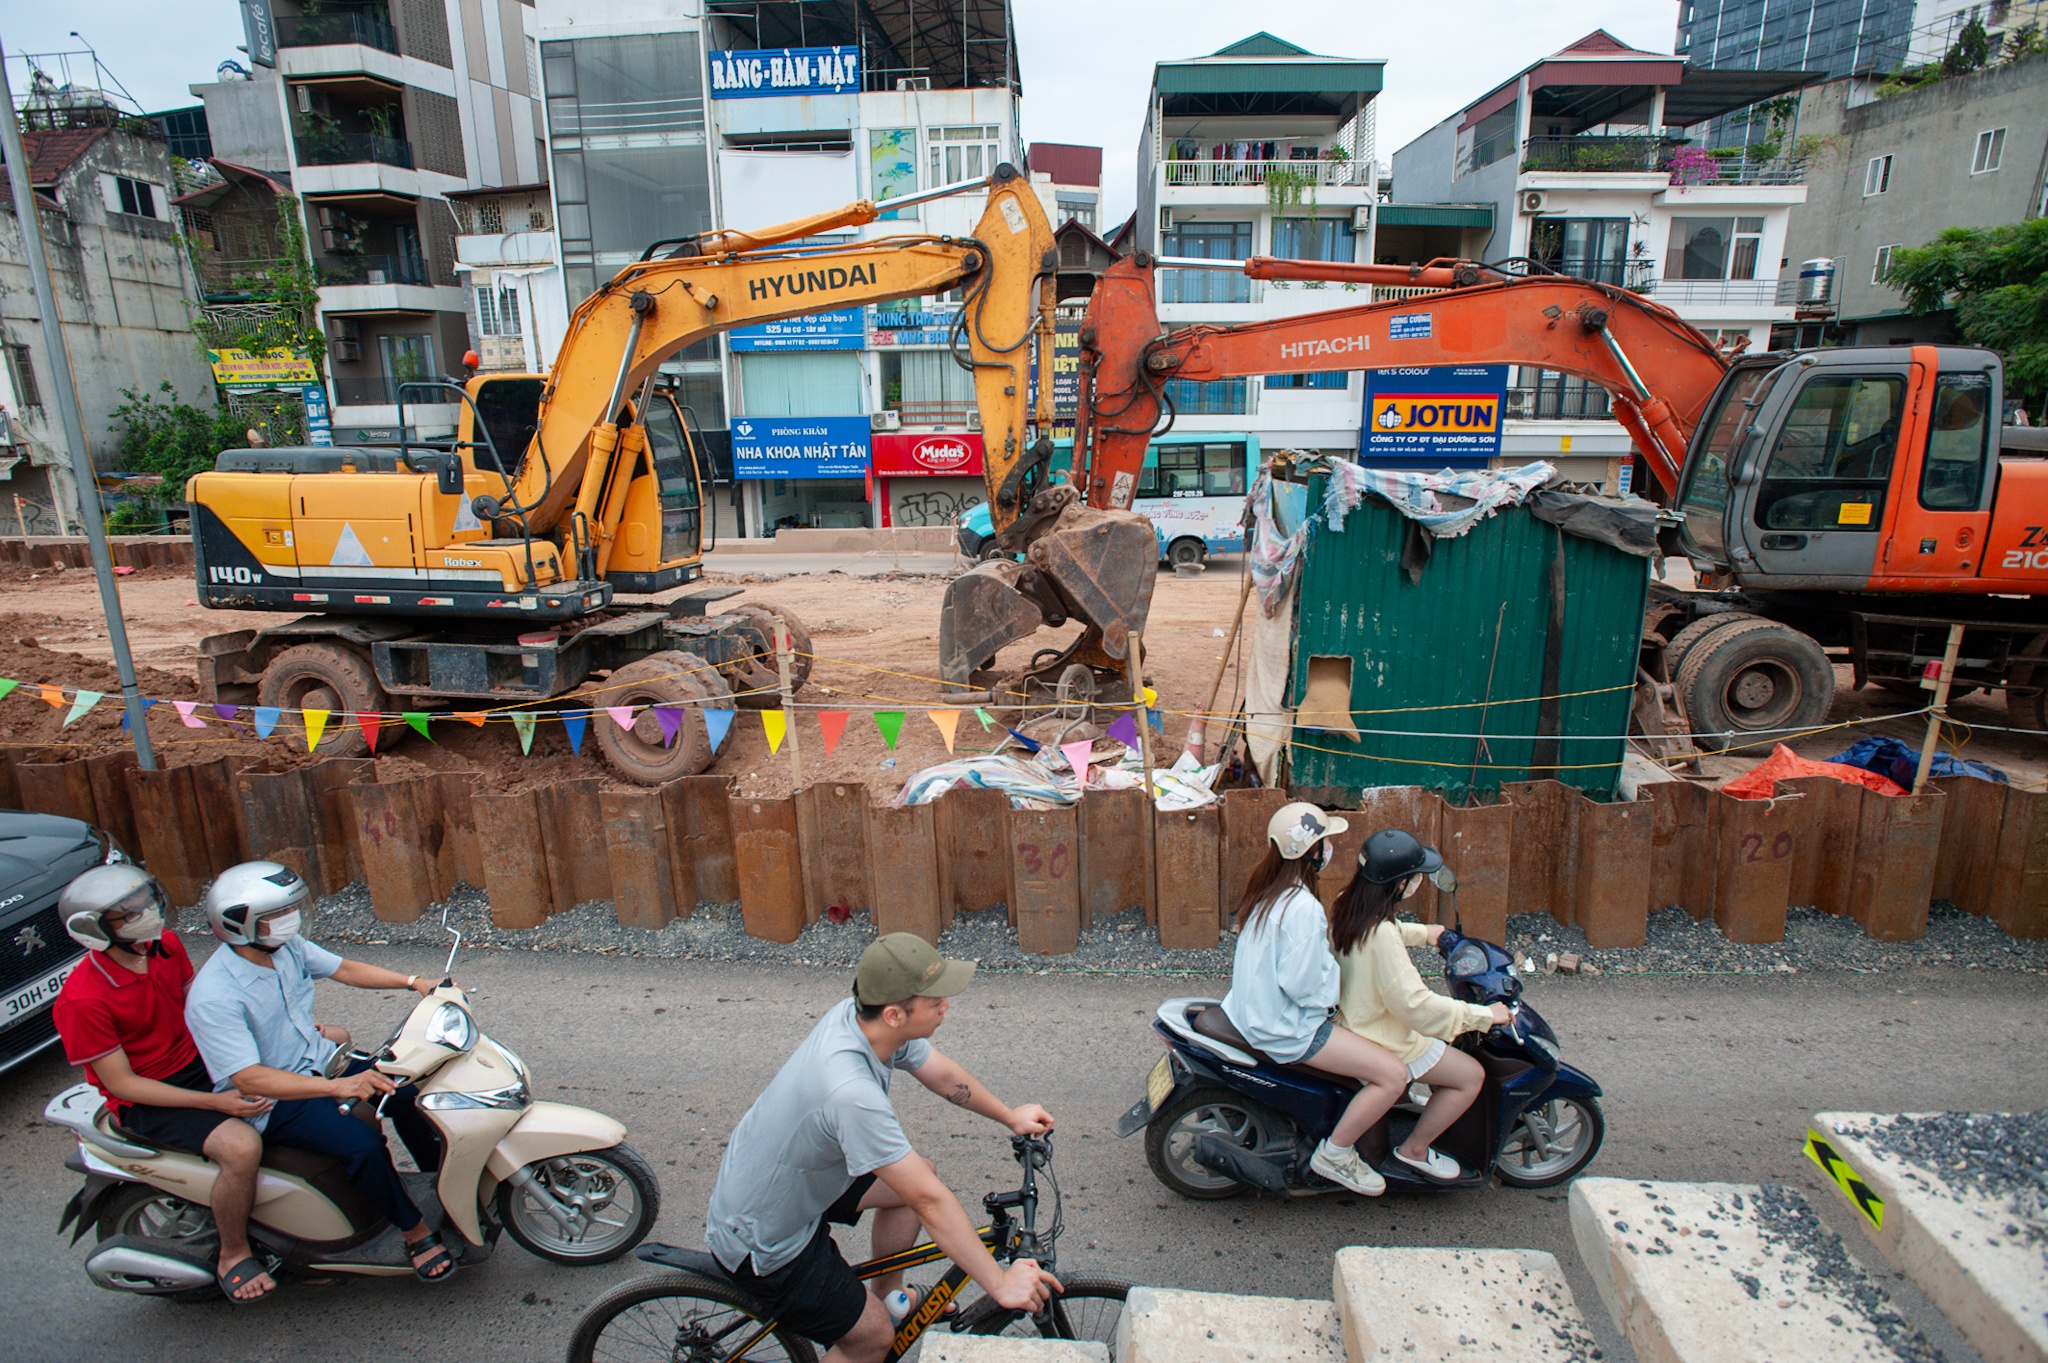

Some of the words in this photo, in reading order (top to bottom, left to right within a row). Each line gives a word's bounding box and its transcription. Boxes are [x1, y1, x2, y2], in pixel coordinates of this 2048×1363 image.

[250, 4, 272, 61] lecafé
[749, 263, 877, 300] HYUNDAI
[766, 325, 782, 334] 525
[867, 312, 907, 326] TRUNG
[872, 331, 894, 345] 525
[897, 330, 925, 344] MUA
[1281, 335, 1370, 359] HITACHI
[1405, 404, 1493, 428] JOTUN
[772, 426, 801, 436] PHÒNG
[802, 426, 828, 436] KHÁM
[1370, 434, 1394, 443] CÔNG
[736, 446, 763, 459] NHA
[766, 446, 801, 459] KHOA
[804, 442, 838, 462] NHẬT
[841, 442, 866, 458] TÂN
[1741, 831, 1793, 863] 20
[1017, 842, 1069, 879] 30
[892, 1280, 952, 1357] maruishi
